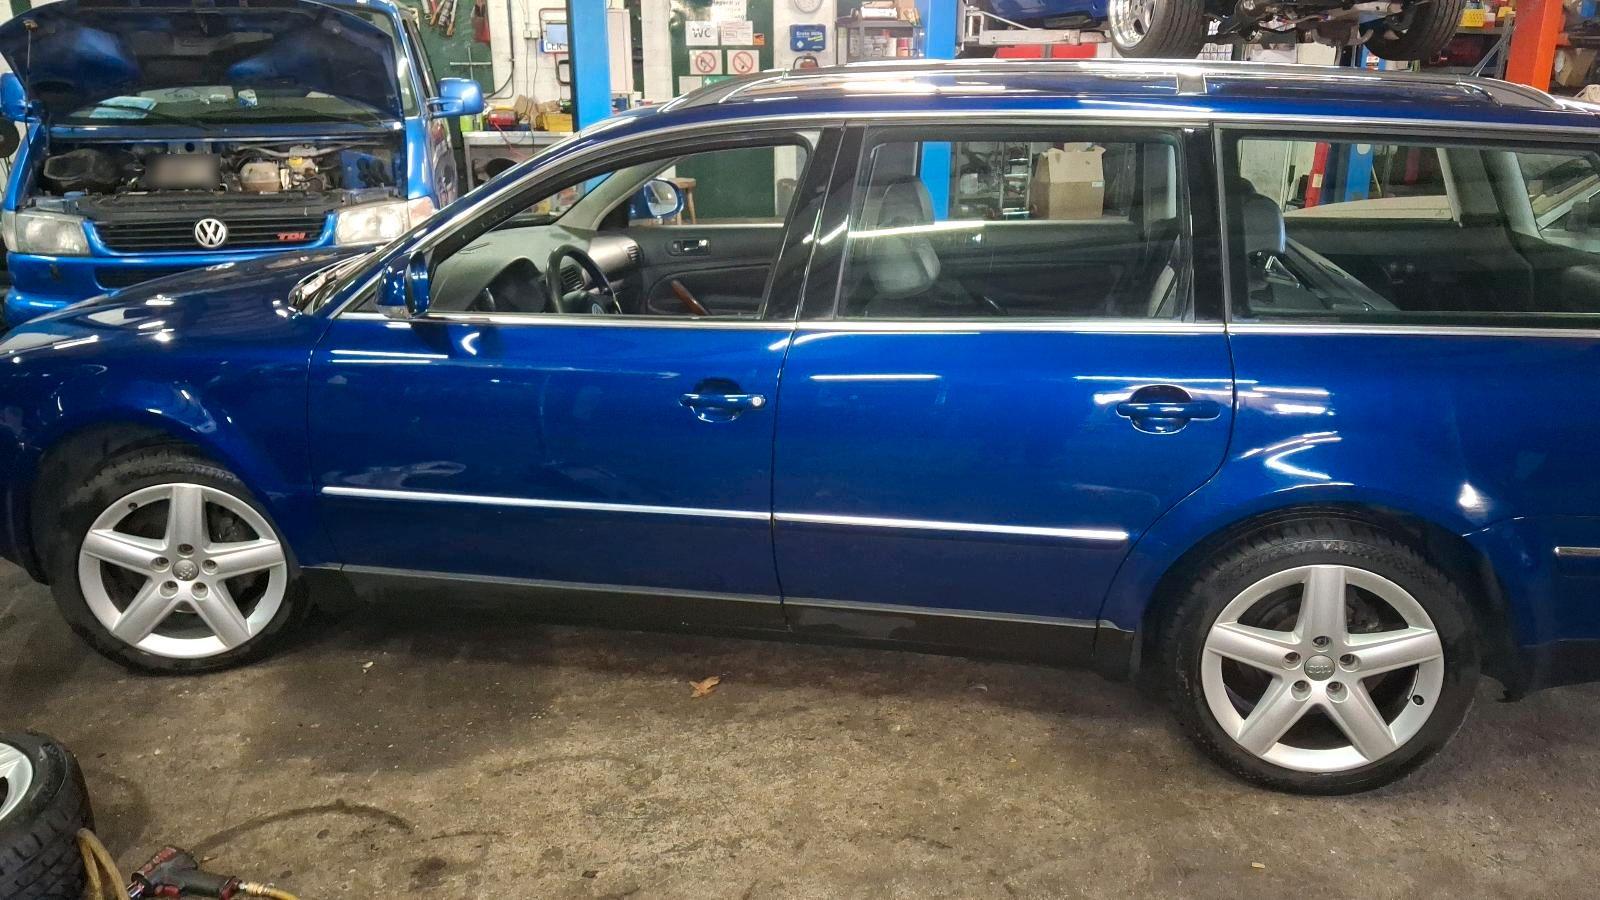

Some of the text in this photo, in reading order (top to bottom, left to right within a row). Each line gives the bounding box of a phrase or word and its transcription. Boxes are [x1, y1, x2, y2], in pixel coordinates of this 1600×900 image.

[692, 28, 711, 38] WC
[195, 218, 226, 248] VW
[276, 232, 307, 242] TDI
